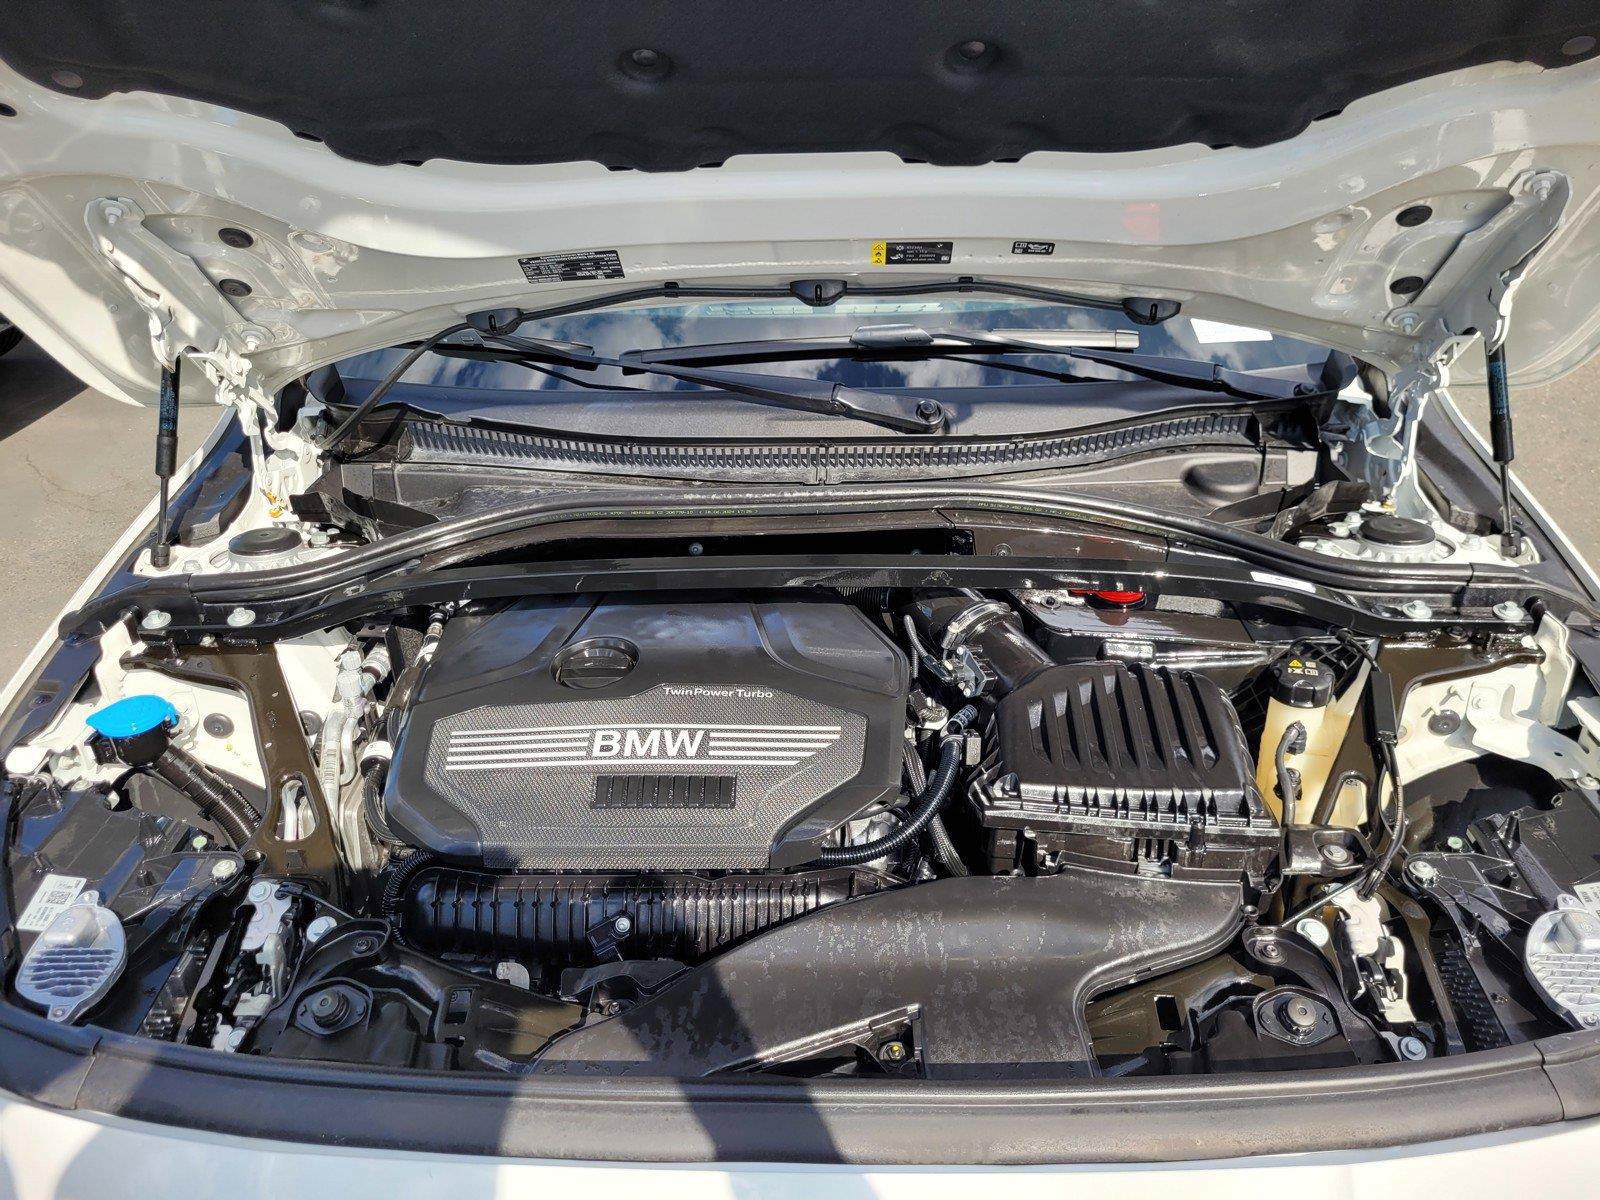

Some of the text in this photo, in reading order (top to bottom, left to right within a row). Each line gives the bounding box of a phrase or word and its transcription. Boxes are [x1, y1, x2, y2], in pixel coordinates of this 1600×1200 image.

[663, 687, 773, 698] TwinPower Turbo
[591, 729, 706, 757] BMW
